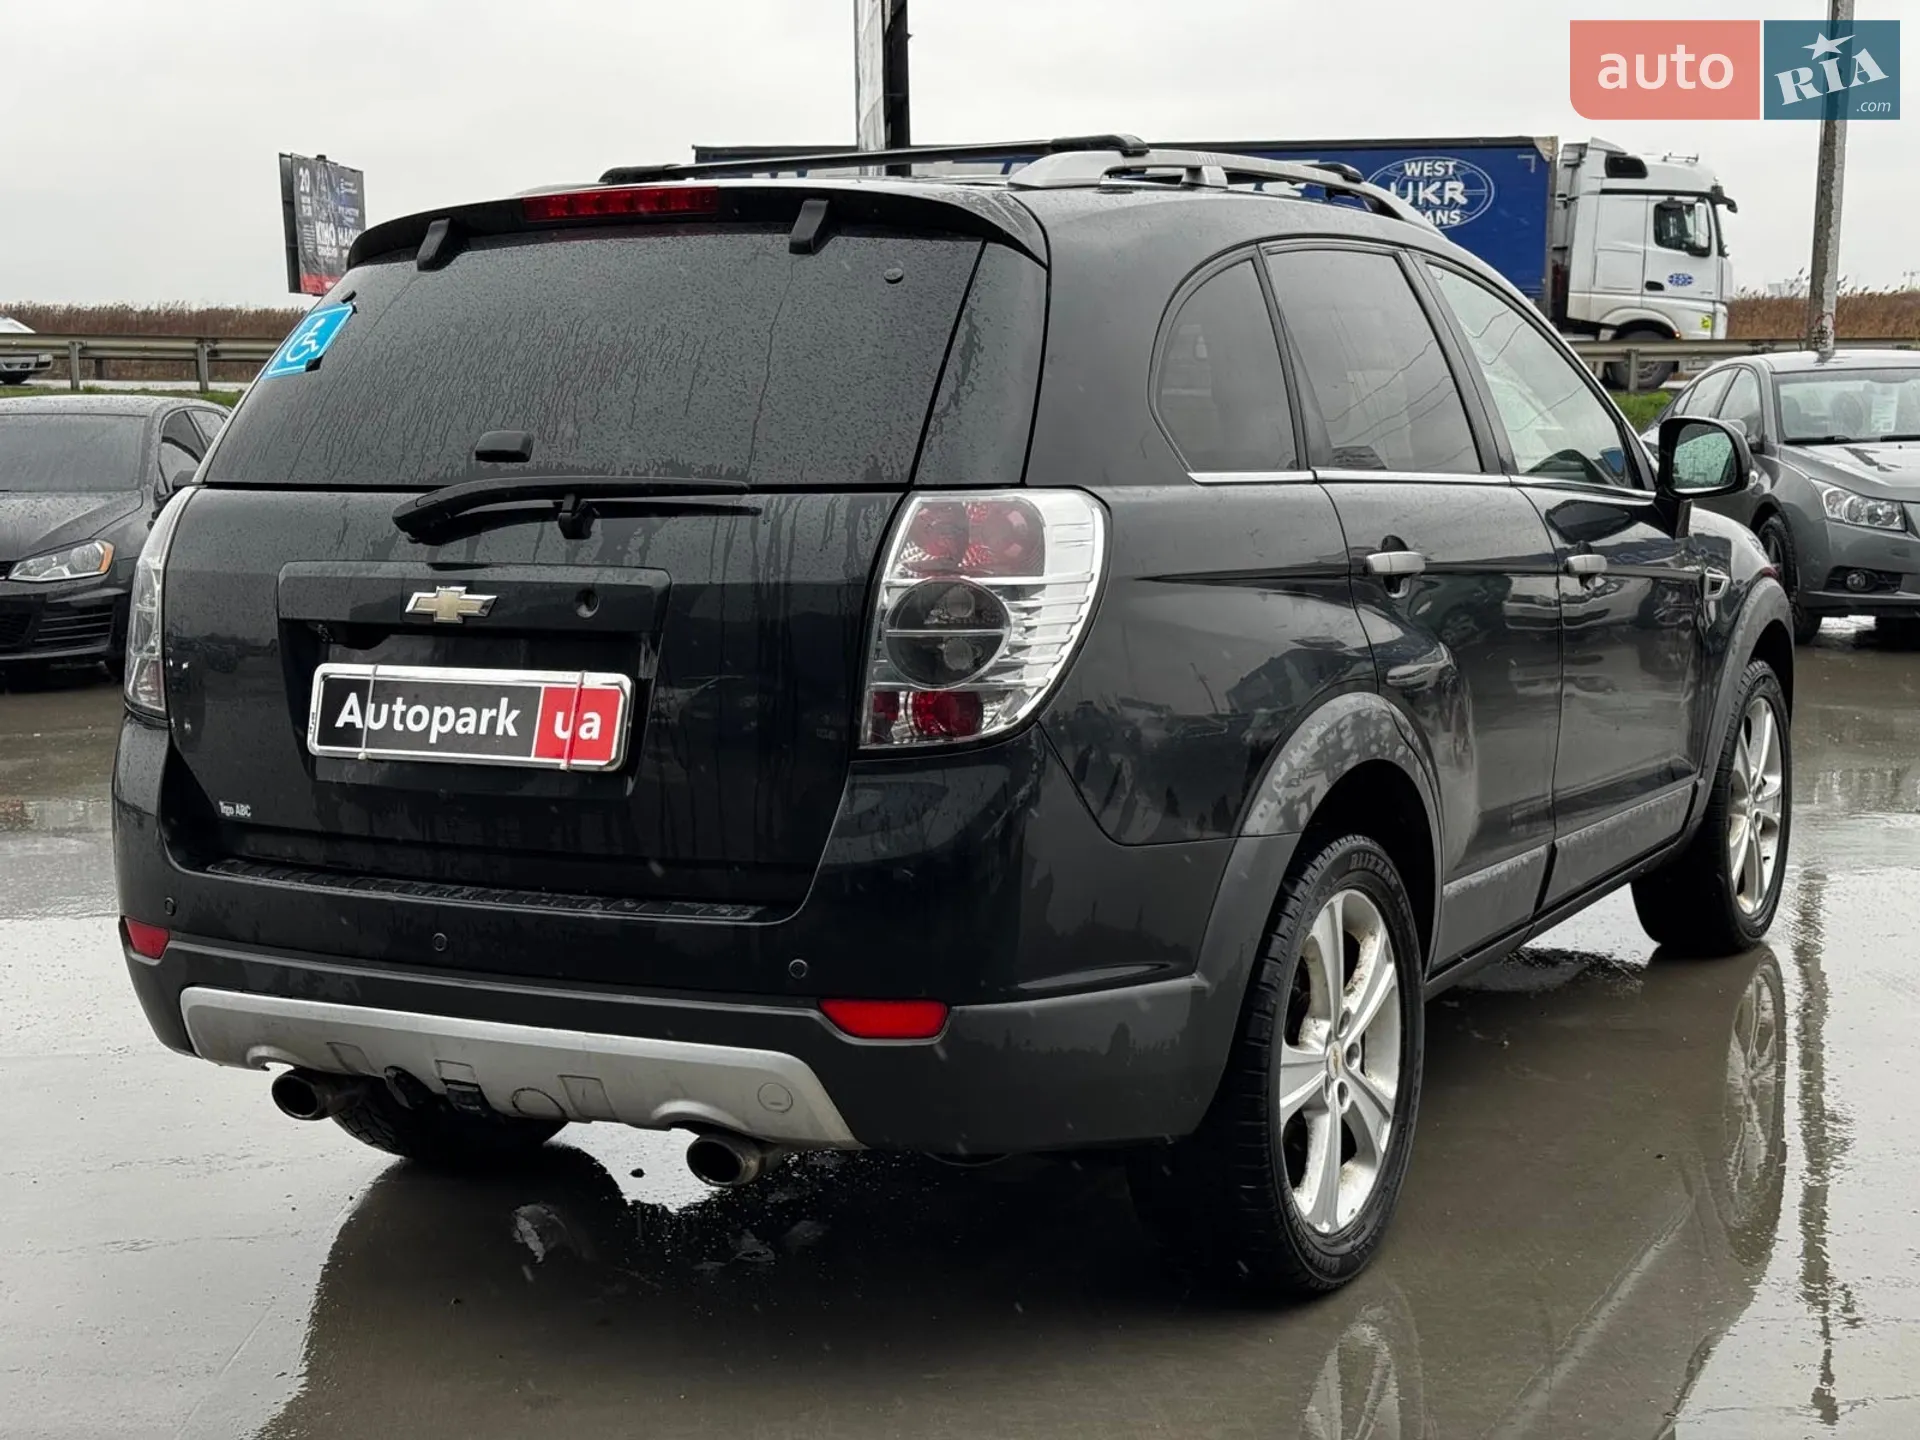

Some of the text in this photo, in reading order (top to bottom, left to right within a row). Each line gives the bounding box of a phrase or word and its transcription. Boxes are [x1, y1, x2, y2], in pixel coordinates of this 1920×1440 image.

[1403, 161, 1457, 177] WEST
[1389, 180, 1469, 206] UKR
[1421, 209, 1461, 226] ANS
[334, 691, 522, 744] Autopark
[553, 711, 602, 741] ua
